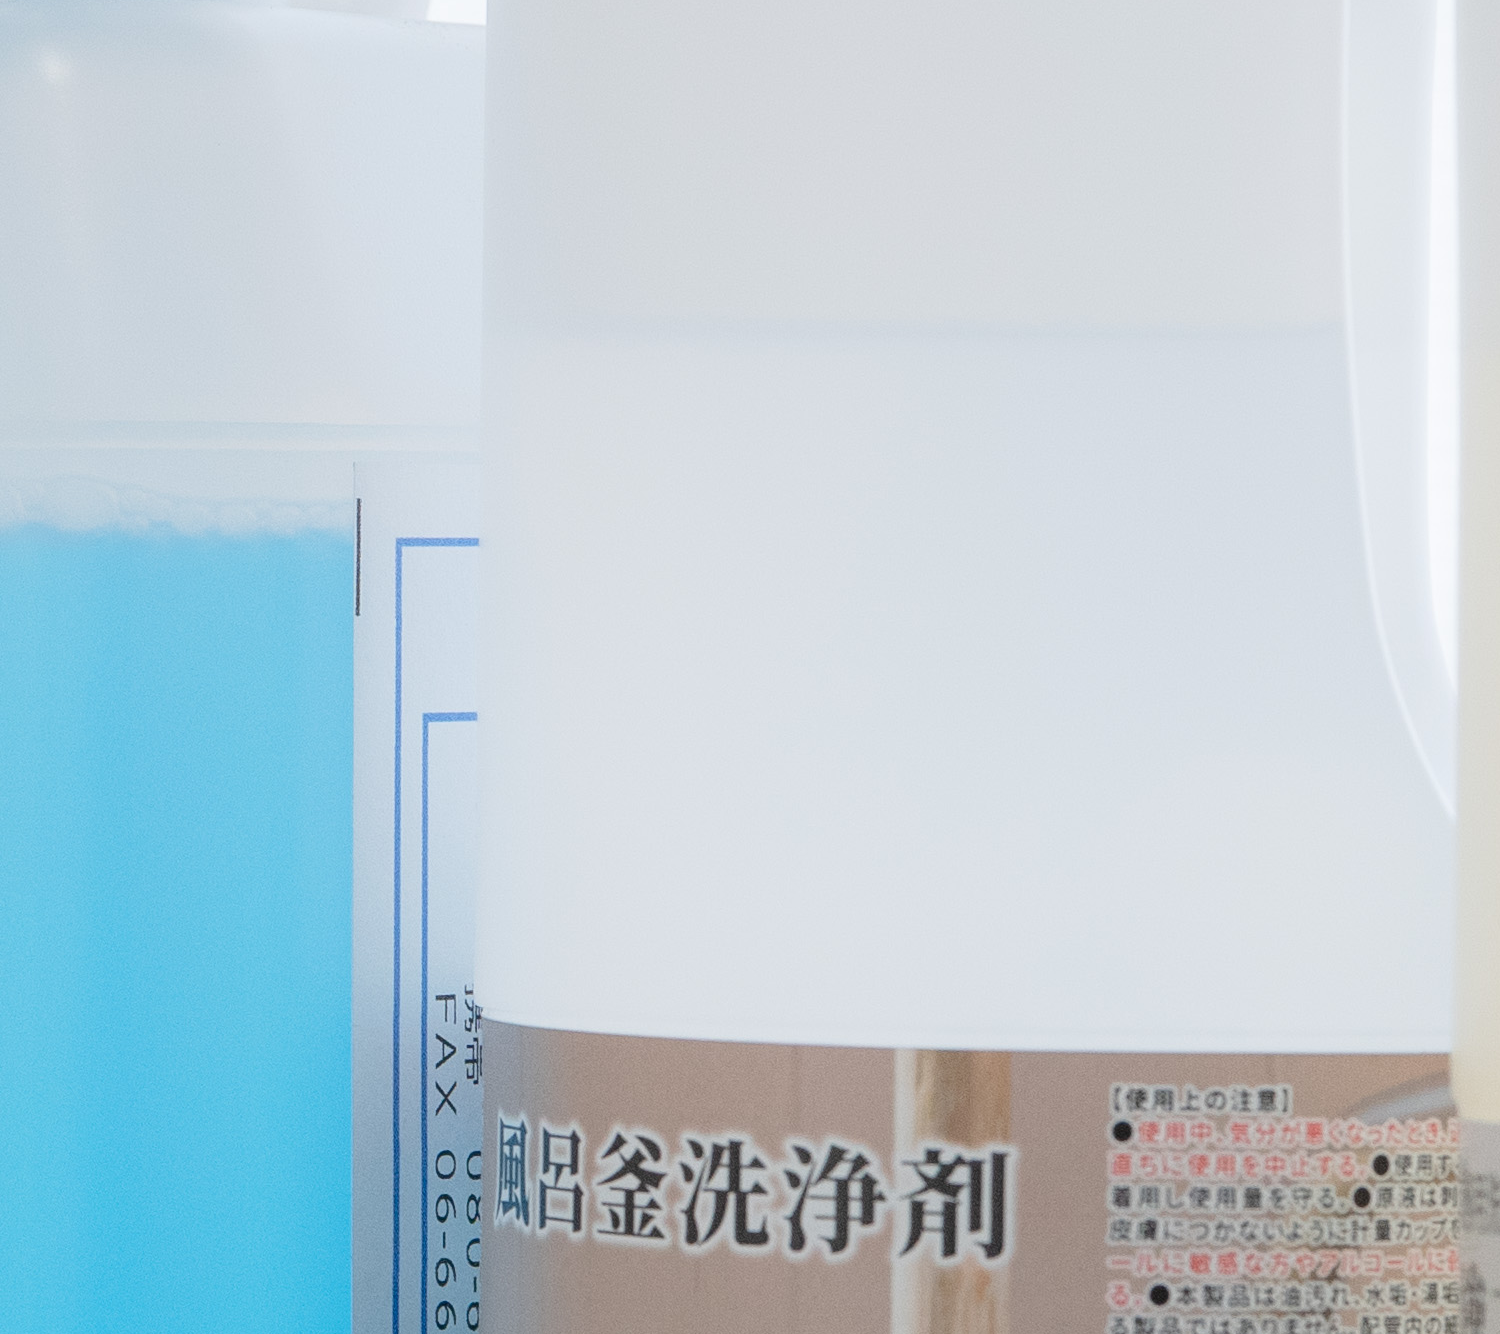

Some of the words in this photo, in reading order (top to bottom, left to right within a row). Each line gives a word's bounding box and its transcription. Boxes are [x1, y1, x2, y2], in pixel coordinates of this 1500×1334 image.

[435, 994, 458, 1117] FAX
[496, 1116, 1010, 1260] 風呂釜洗浄剤
